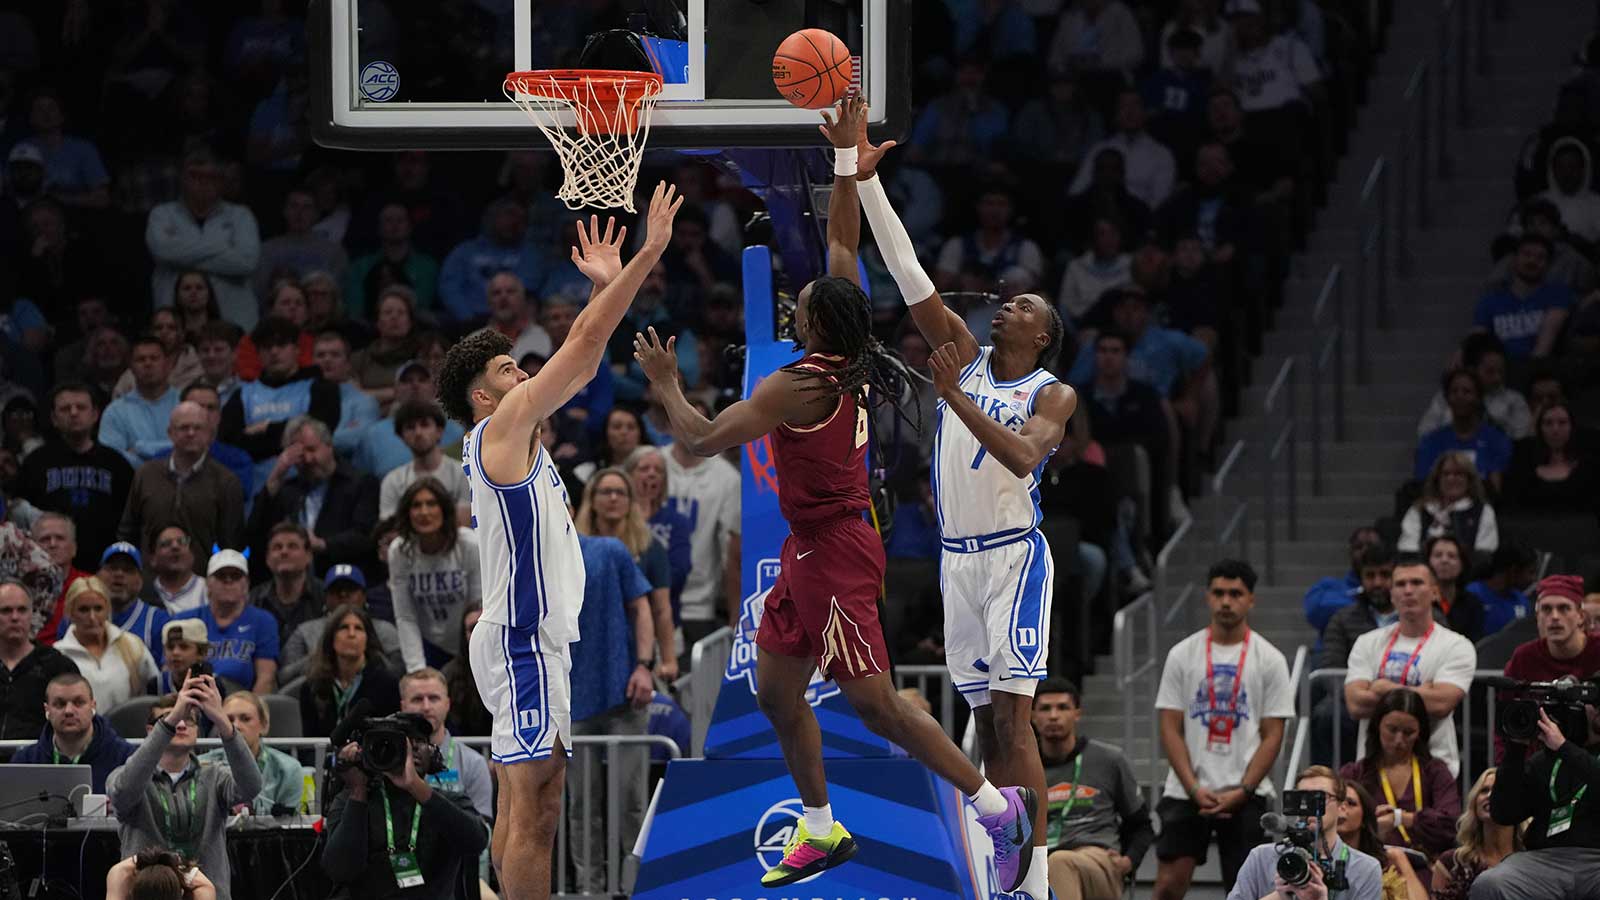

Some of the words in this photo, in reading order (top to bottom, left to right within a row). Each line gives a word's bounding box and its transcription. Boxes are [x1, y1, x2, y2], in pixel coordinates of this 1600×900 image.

[366, 74, 397, 84] ACC
[965, 538, 979, 552] D
[1017, 627, 1036, 647] D
[519, 708, 540, 730] D
